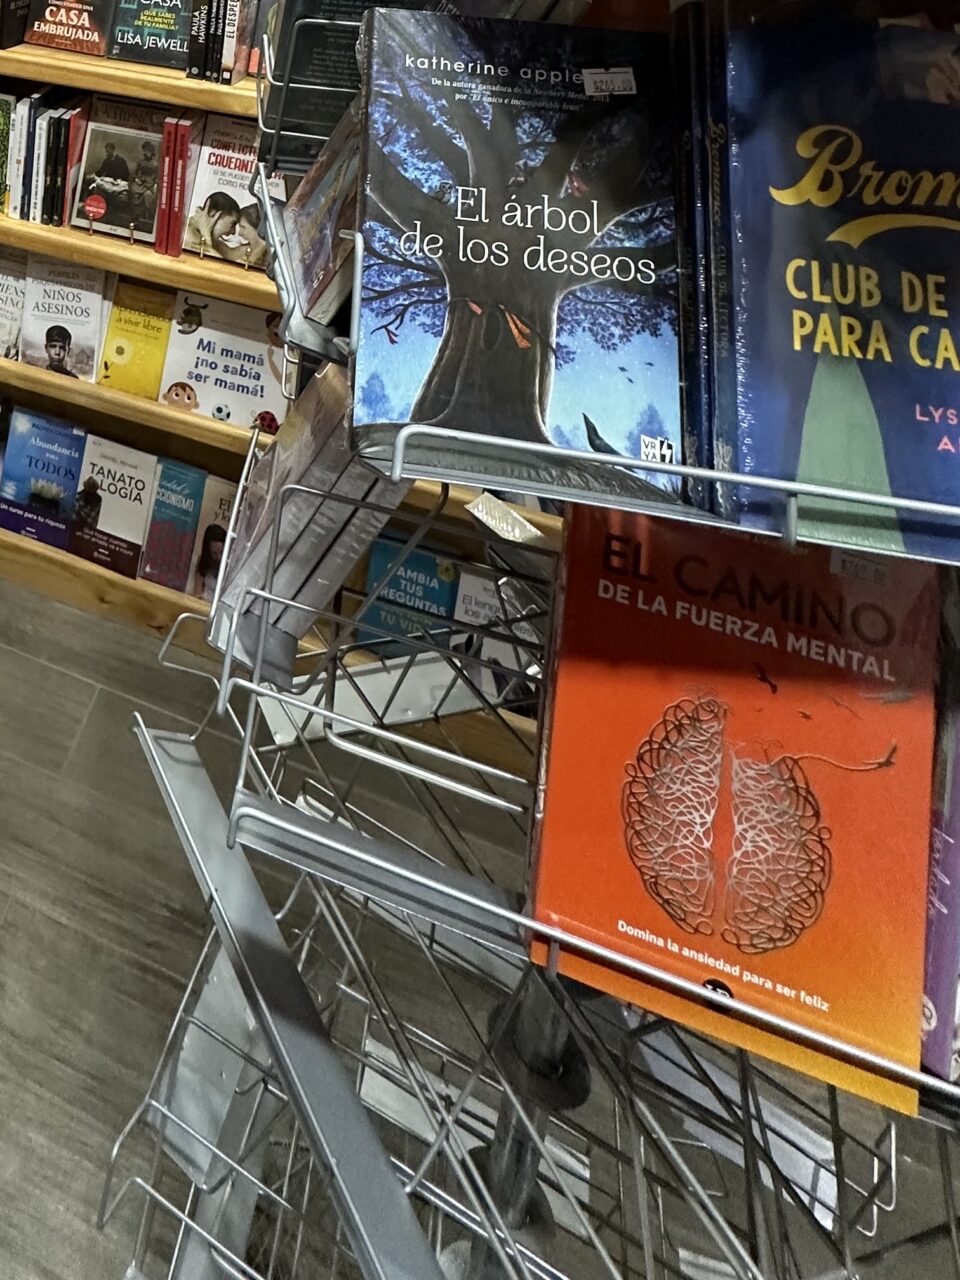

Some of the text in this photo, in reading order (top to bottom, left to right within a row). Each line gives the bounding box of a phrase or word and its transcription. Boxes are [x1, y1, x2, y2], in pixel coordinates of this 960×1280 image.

[44, 6, 90, 28] CASA
[191, 10, 201, 37] PAULA
[198, 4, 208, 44] HAWKINS
[33, 21, 100, 43] EMBRUJADA
[117, 31, 189, 53] LISA JEWELL
[405, 53, 509, 78] katherine
[453, 80, 477, 89] autora
[454, 184, 603, 237] El árbol
[399, 220, 658, 286] de los deseos
[42, 288, 82, 304] NIÑOS
[785, 257, 883, 308] CLUB
[901, 270, 950, 319] DE
[32, 301, 90, 318] ASESINOS
[143, 319, 162, 334] libre
[791, 309, 893, 364] PARA
[195, 337, 265, 368] Mi mamá
[186, 370, 266, 399] ser mamá!
[221, 362, 263, 383] sabía
[29, 435, 79, 459] Abundancia
[26, 453, 77, 482] TODOS
[89, 462, 146, 492] TANATO
[99, 481, 143, 505] LOGÍA
[400, 579, 424, 598] TUS
[601, 533, 897, 649] EL CAMINO
[597, 578, 896, 683] DE LA FUERZA MENTAL
[616, 918, 830, 1012] Domina la ansiedad para ser feliz
